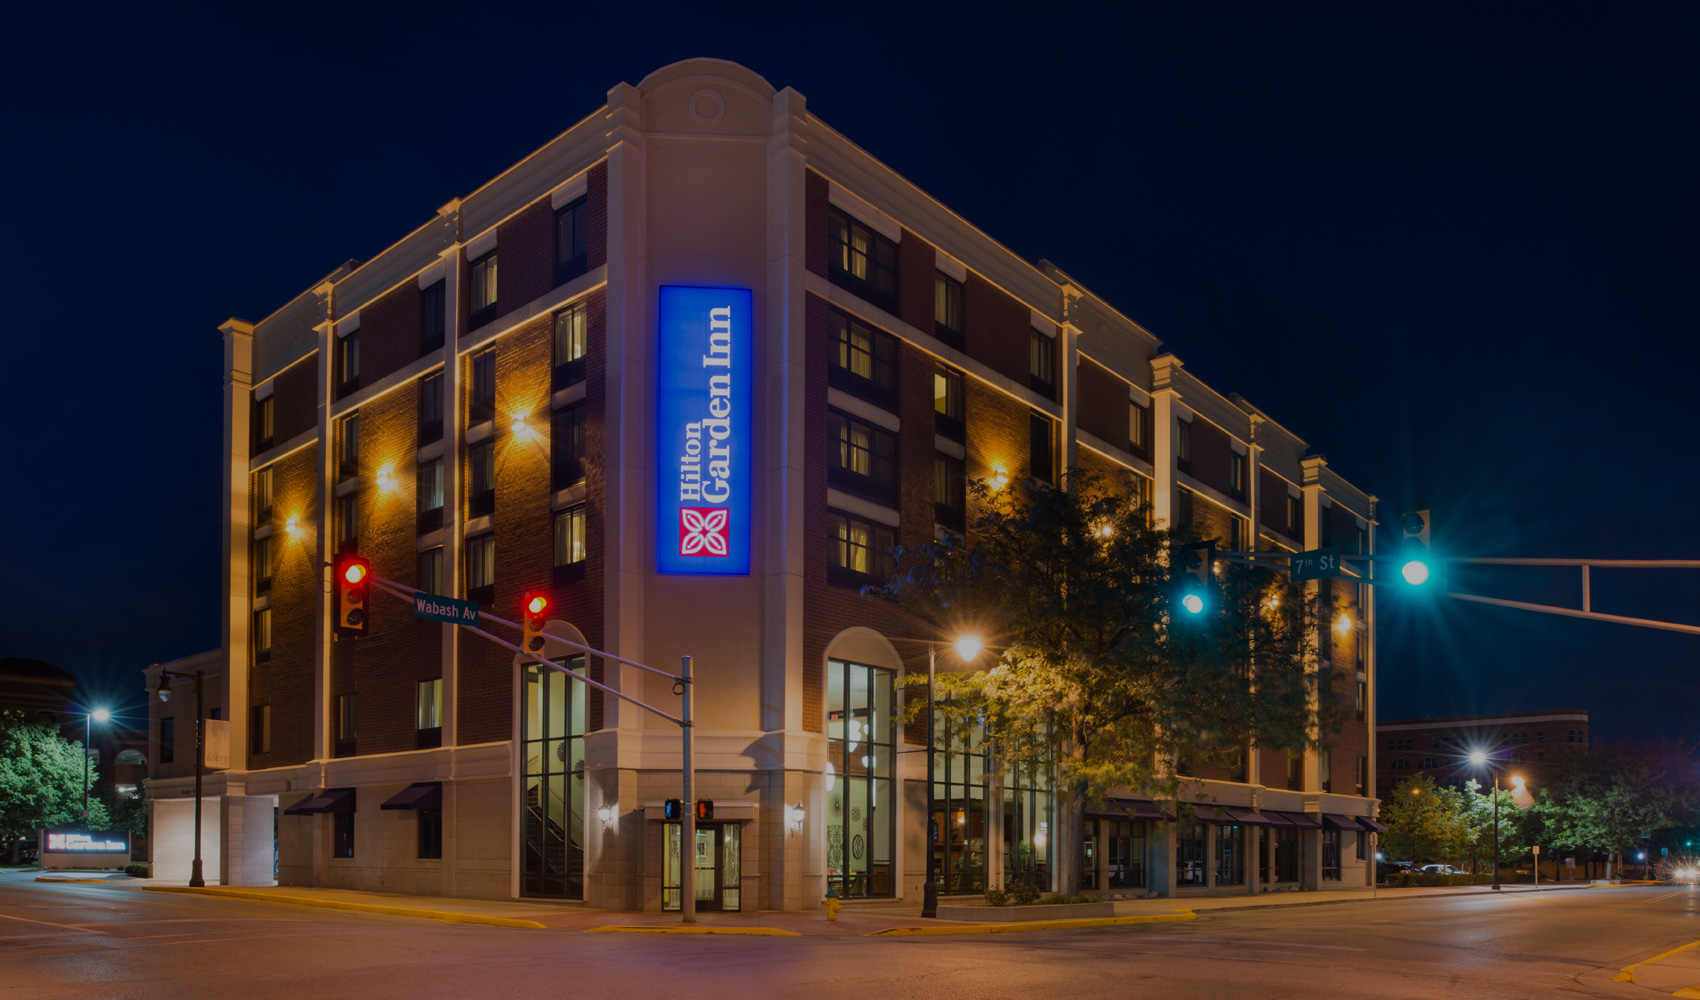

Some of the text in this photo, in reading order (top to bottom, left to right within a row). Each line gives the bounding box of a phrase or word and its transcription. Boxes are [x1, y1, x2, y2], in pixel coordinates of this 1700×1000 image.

[701, 305, 731, 504] Garden Inn
[680, 421, 702, 502] Hilton
[1296, 555, 1334, 574] 7th St
[416, 598, 476, 620] Wabash Av
